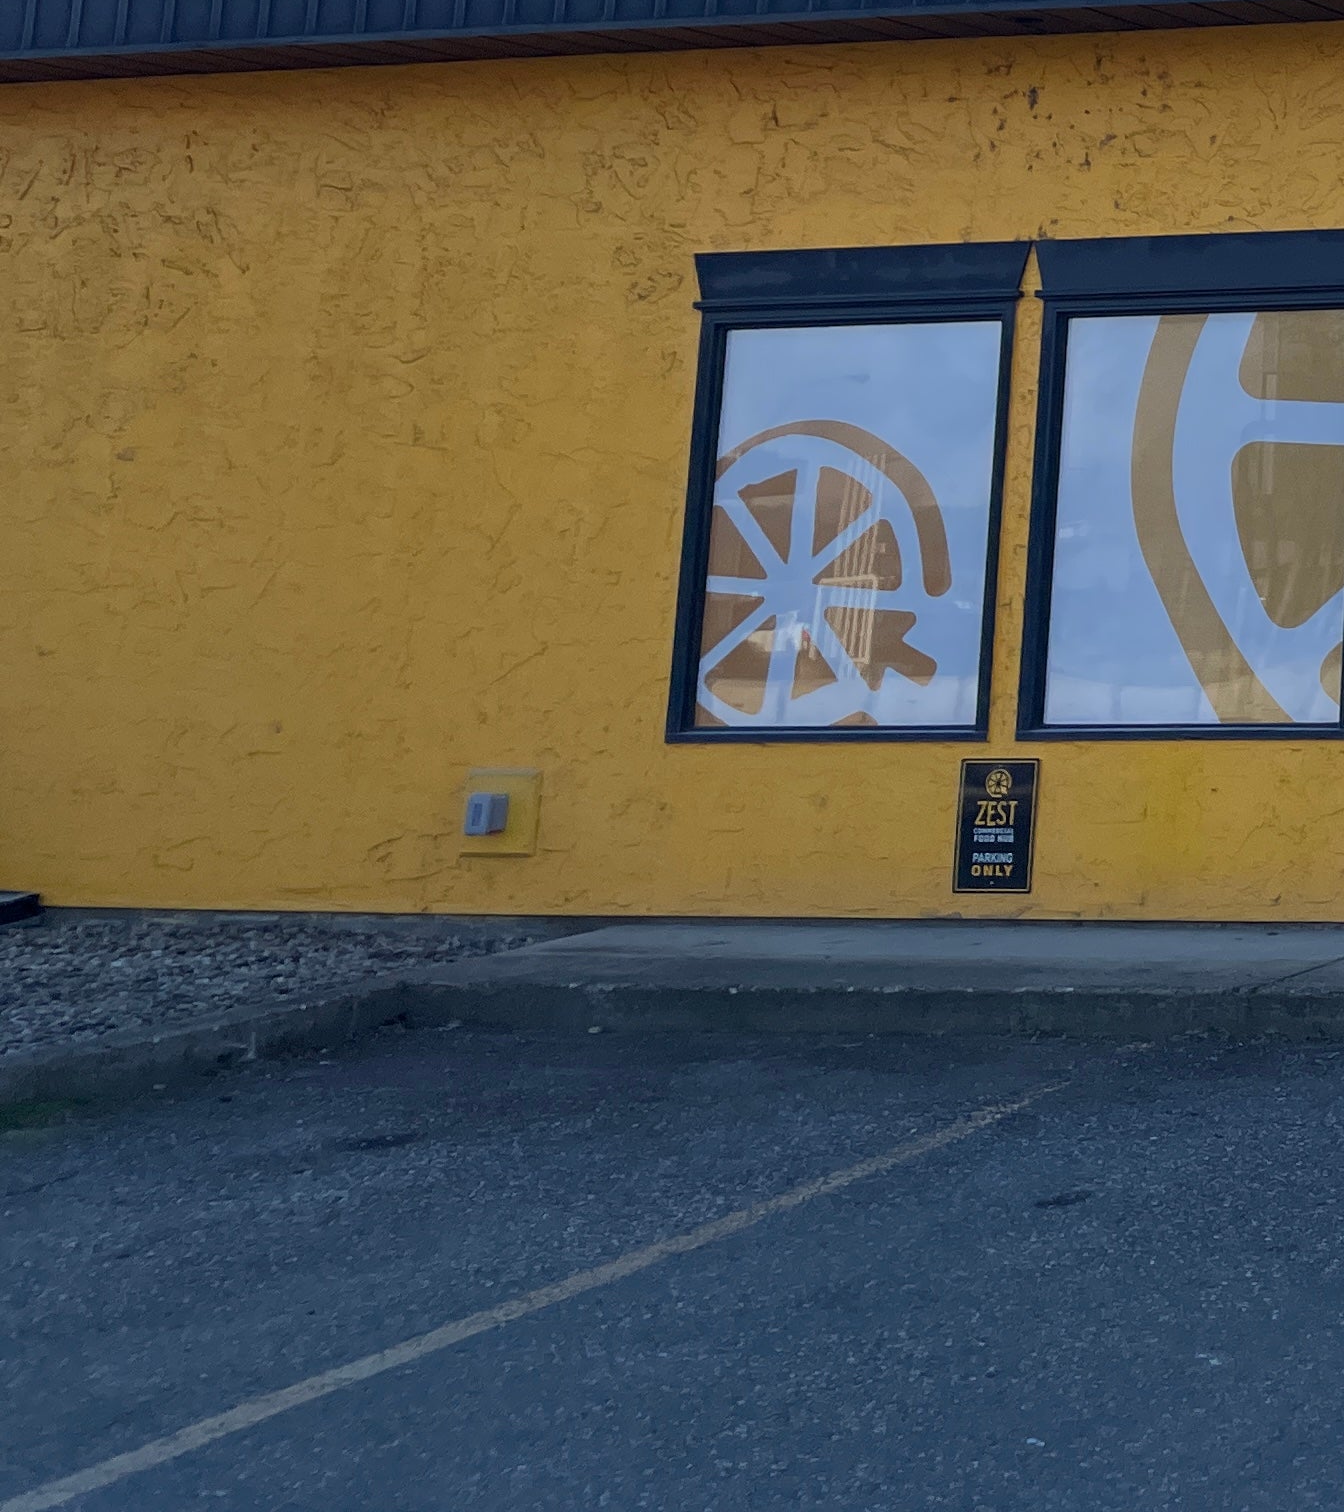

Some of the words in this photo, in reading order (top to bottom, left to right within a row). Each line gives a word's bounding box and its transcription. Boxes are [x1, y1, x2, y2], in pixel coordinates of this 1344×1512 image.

[974, 800, 1018, 826] ZEST
[972, 852, 1013, 863] PARKING
[970, 864, 1013, 877] ONLY
